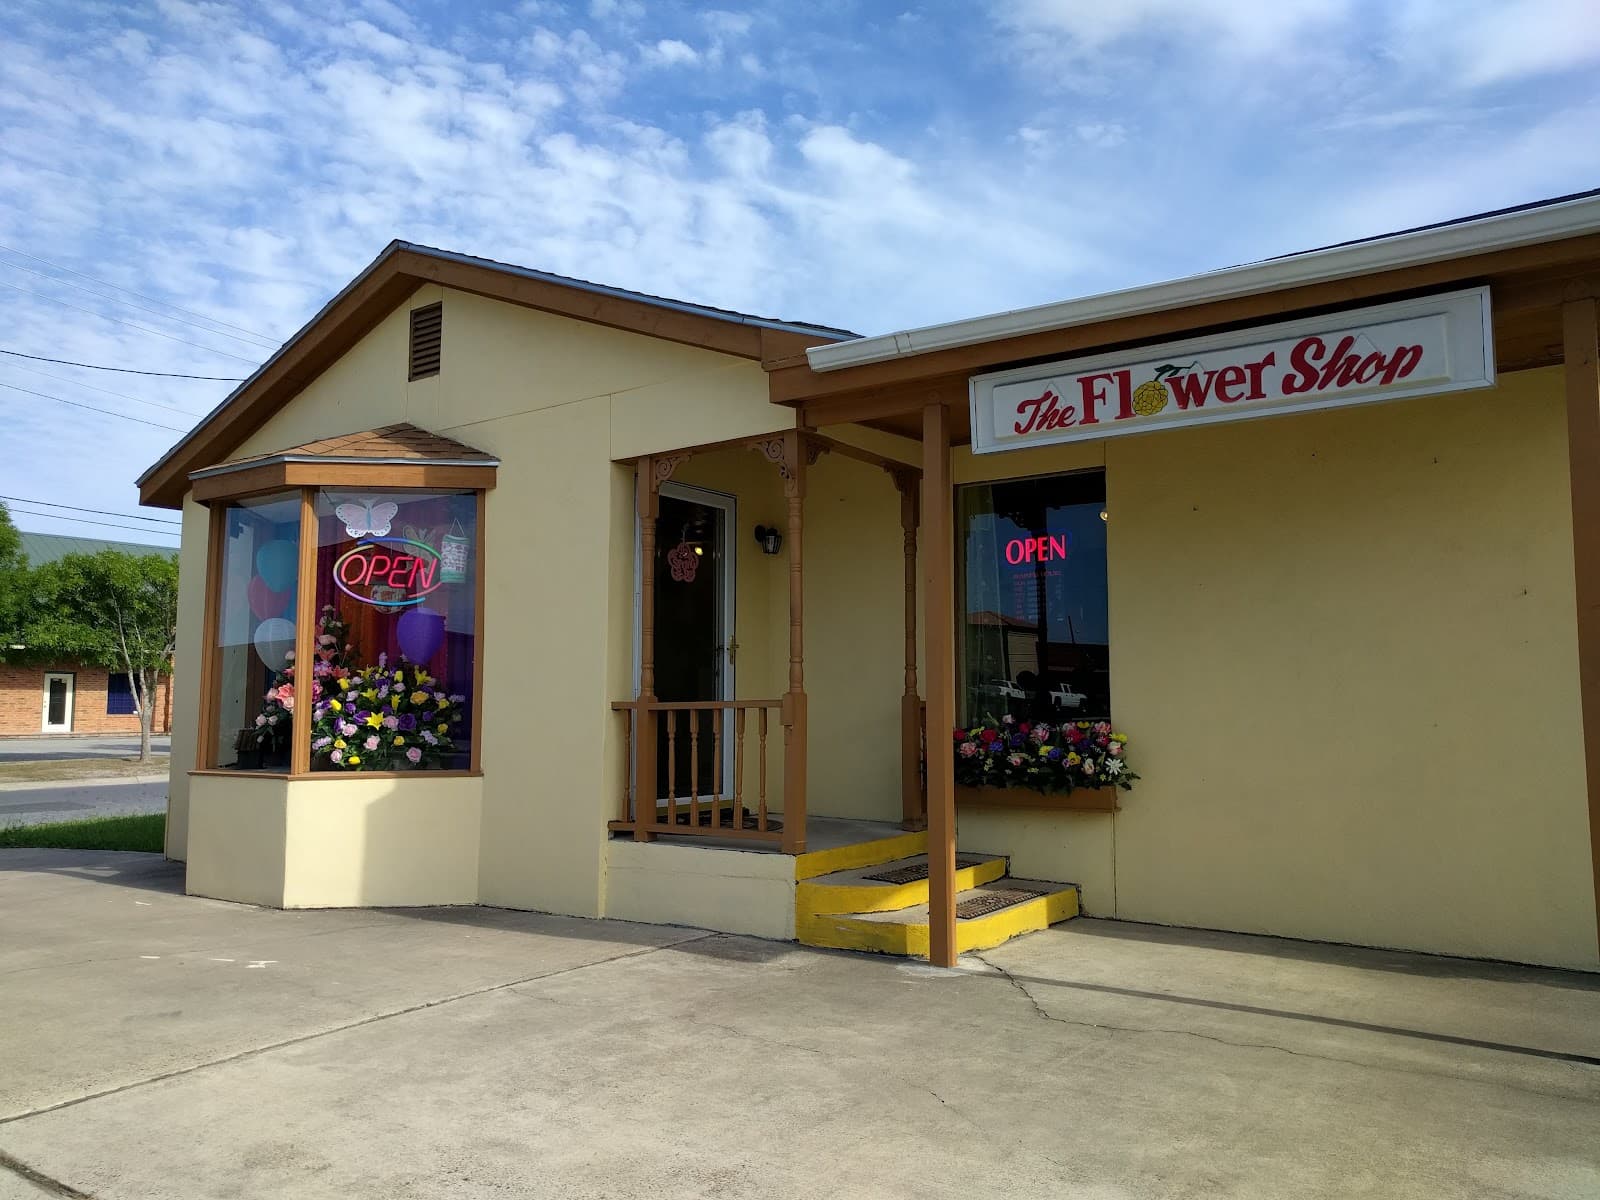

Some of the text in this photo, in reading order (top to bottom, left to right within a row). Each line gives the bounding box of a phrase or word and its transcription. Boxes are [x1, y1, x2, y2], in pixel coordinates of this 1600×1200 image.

[1014, 335, 1423, 435] The Flower Shop
[1005, 534, 1066, 565] OPEN
[340, 554, 438, 589] OPEN
